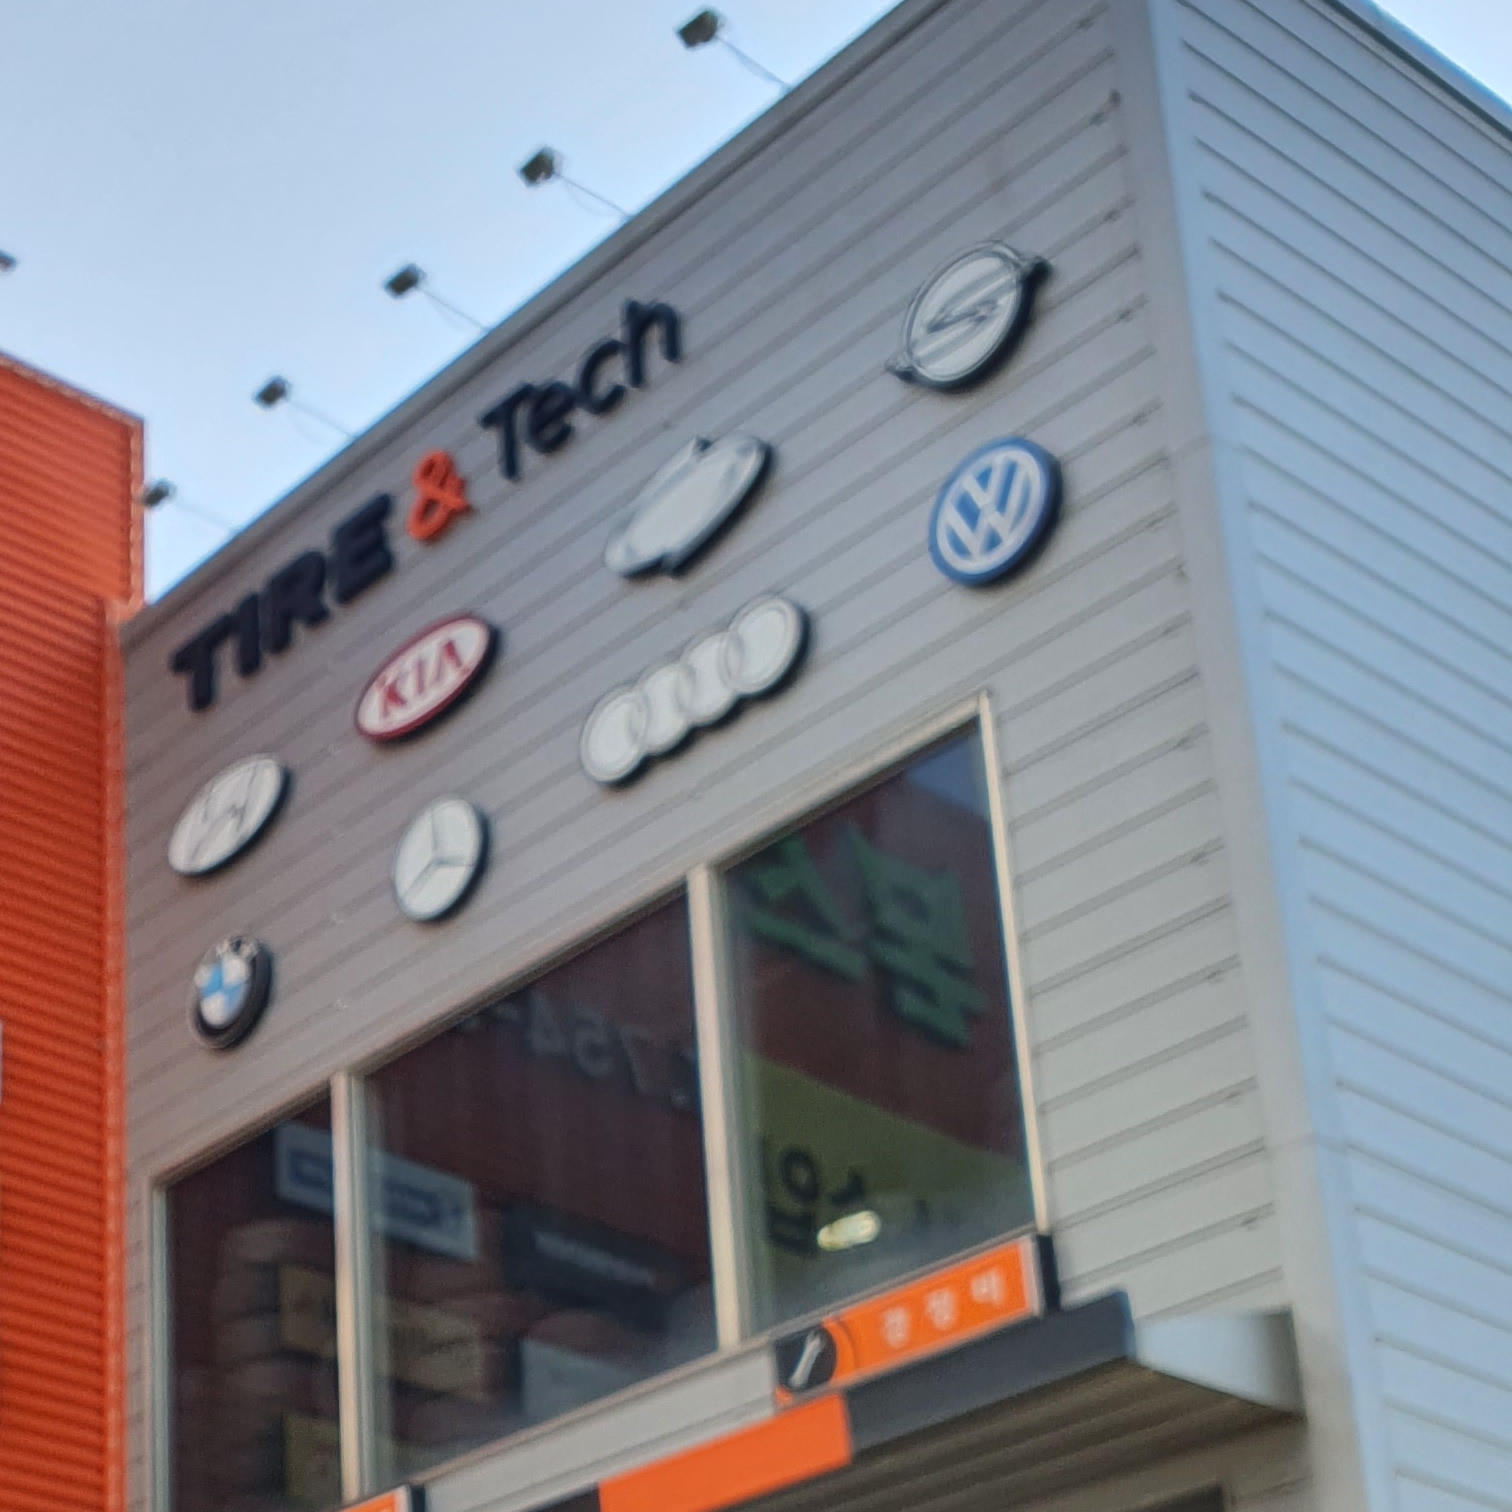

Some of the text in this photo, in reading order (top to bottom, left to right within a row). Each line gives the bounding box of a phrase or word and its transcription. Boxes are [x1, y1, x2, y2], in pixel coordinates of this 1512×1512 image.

[171, 299, 681, 712] TIRE & Tech
[377, 638, 470, 718] KIA
